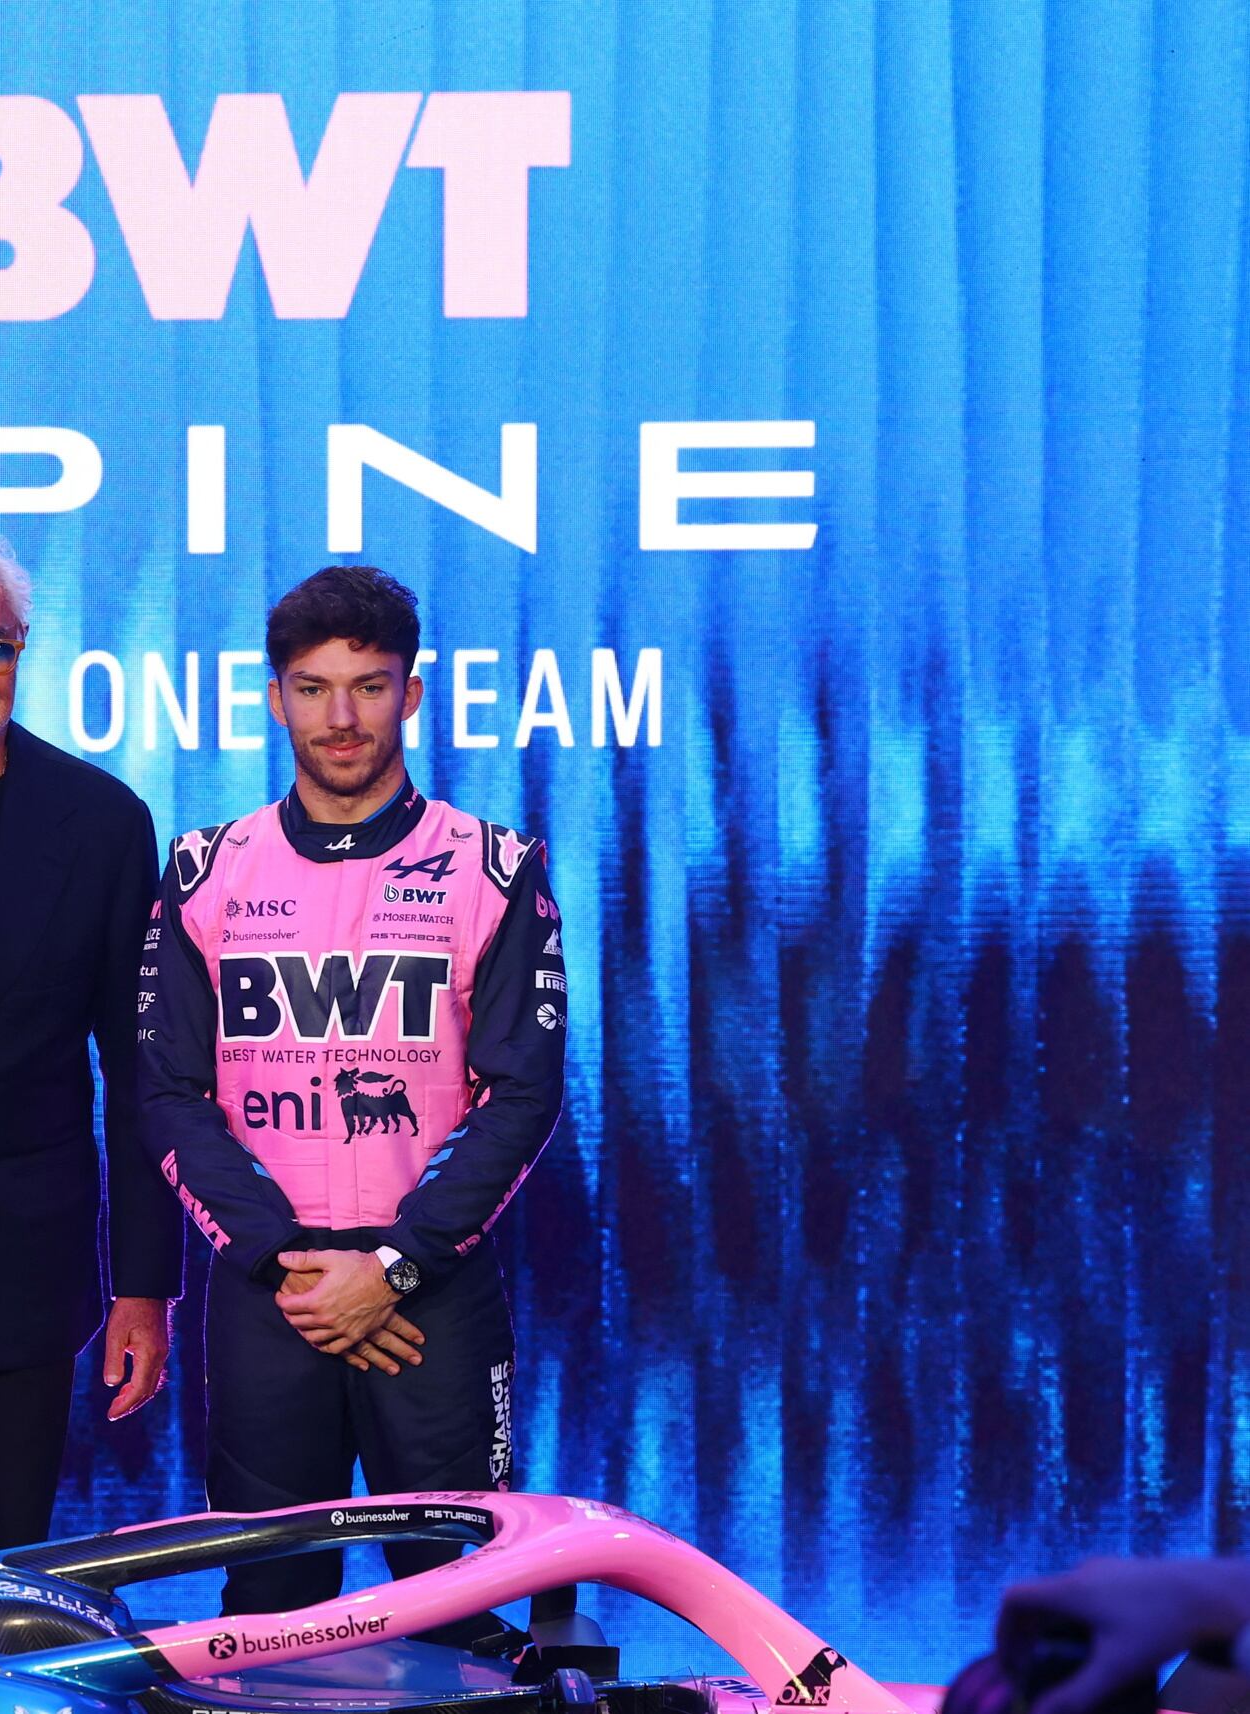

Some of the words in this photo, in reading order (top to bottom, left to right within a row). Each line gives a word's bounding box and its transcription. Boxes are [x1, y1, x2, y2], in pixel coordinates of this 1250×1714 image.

[69, 649, 264, 752] ONE
[402, 888, 447, 904] BWT
[245, 899, 297, 917] MSC
[233, 930, 296, 943] businessolver
[535, 969, 568, 993] PIRE
[219, 949, 453, 1044] BWT
[222, 1048, 256, 1063] BEST
[263, 1050, 316, 1064] WATER
[323, 1048, 442, 1063] TECHNOLOGY
[243, 1076, 322, 1131] eni
[346, 1509, 410, 1525] businessolver
[242, 1614, 390, 1655] businessolver
